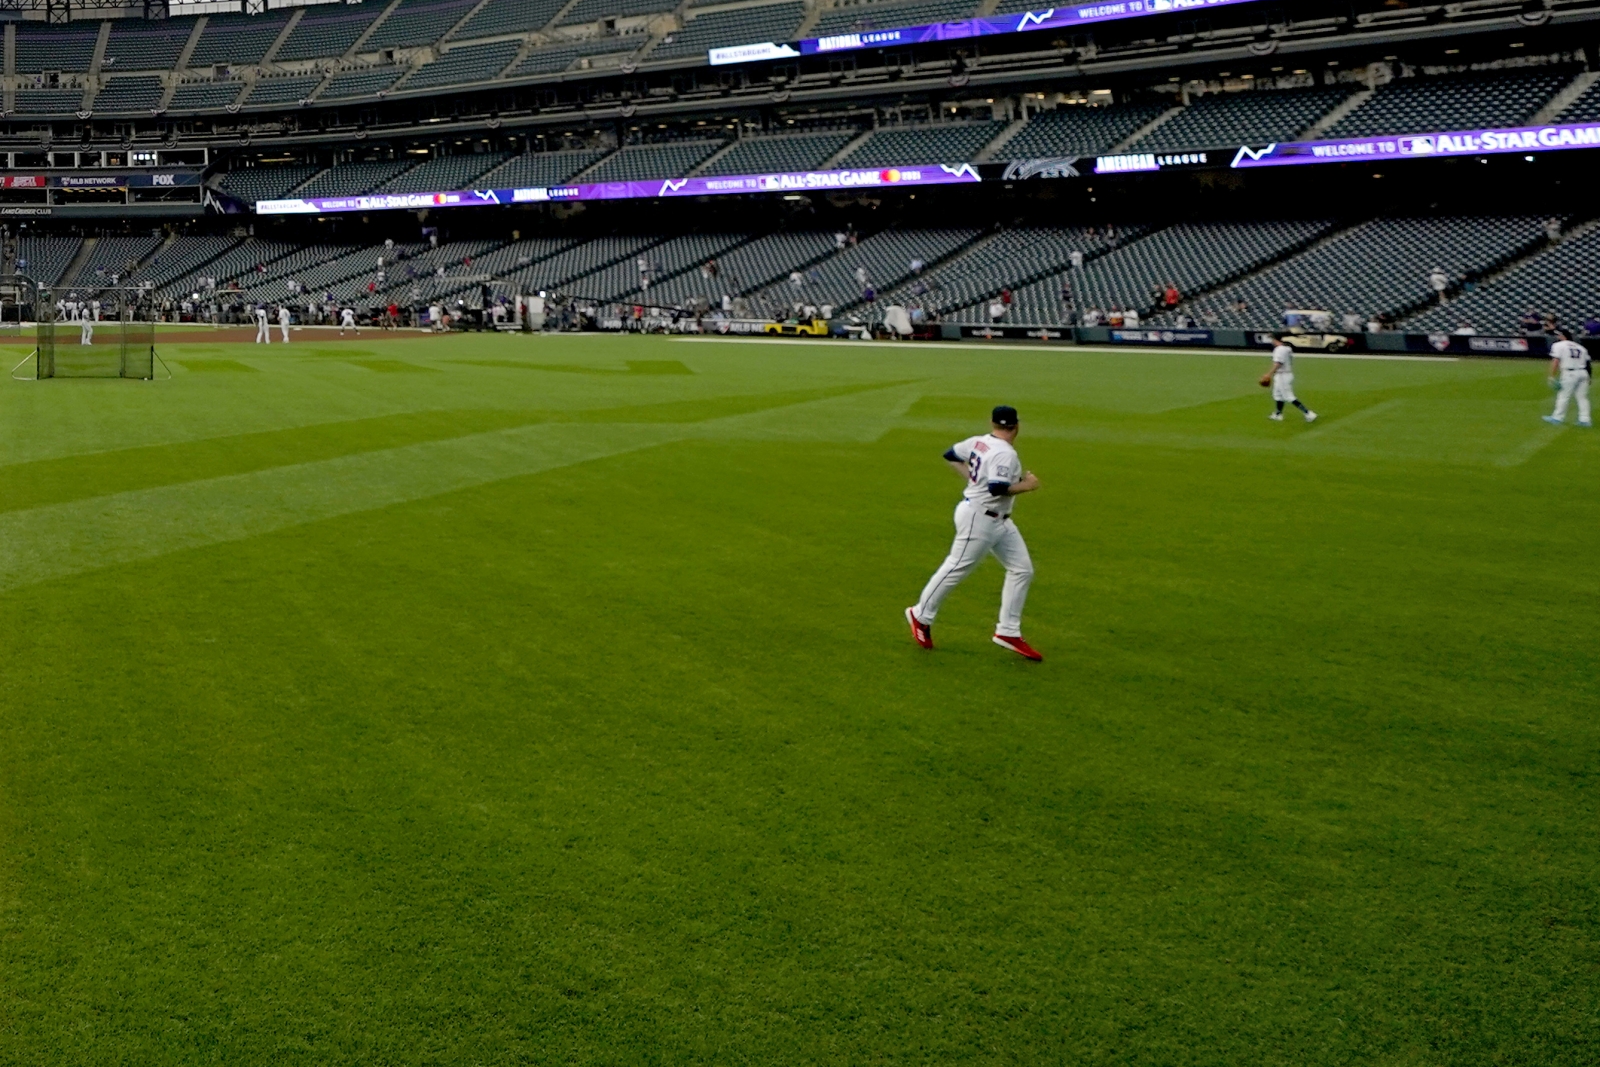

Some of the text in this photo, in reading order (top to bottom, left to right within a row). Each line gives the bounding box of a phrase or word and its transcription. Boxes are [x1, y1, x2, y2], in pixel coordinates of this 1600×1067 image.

[1078, 4, 1125, 19] WELCOME
[1129, 2, 1143, 12] TO
[818, 31, 901, 50] NATIONAL LEAGUE
[1312, 142, 1376, 157] WELCOME
[1377, 142, 1395, 154] TO
[1096, 153, 1207, 170] AMERICAN LEAGUE
[152, 174, 175, 186] FOX
[706, 180, 744, 190] WELCOME
[746, 179, 757, 188] TO
[549, 188, 579, 197] LEAGUE
